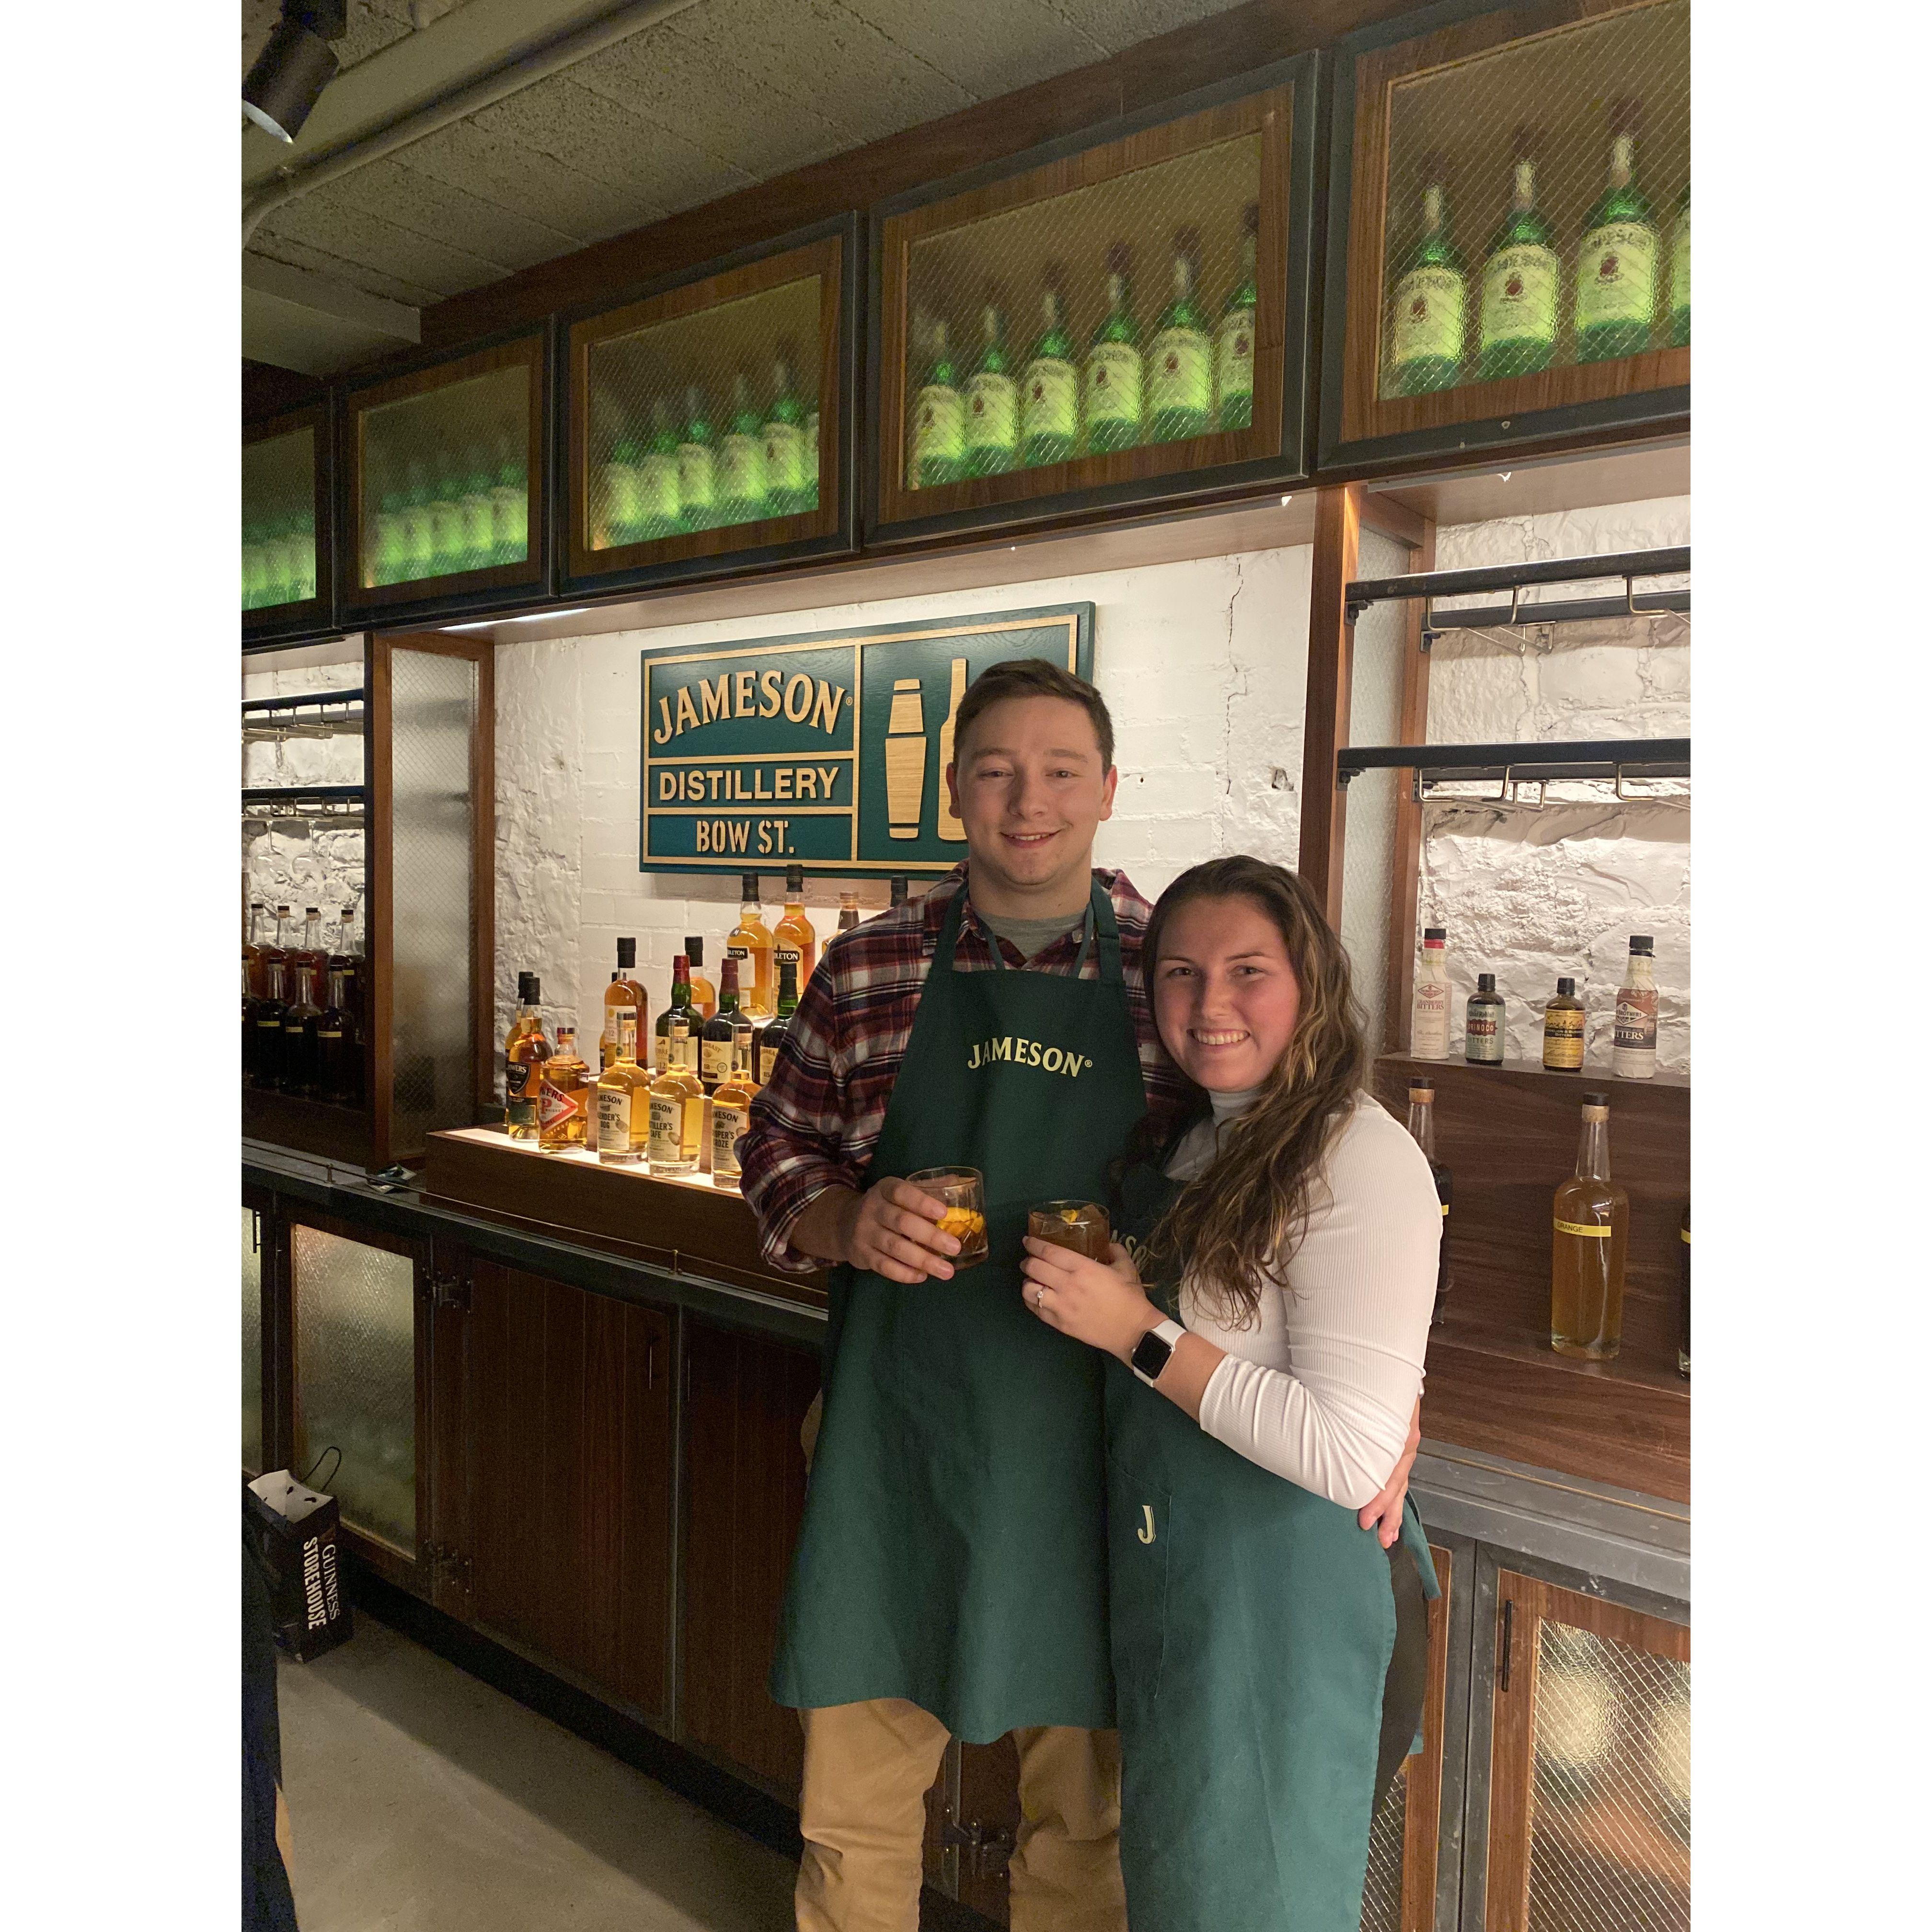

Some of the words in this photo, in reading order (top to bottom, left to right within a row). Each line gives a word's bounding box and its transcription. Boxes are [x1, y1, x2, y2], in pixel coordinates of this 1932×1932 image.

[660, 767, 839, 801] DISTILLERY
[696, 820, 750, 853] BOW
[758, 820, 795, 854] ST.
[1616, 1030, 1644, 1040] TTERS
[598, 1094, 623, 1105] MESON
[649, 1103, 673, 1115] MESON
[713, 1111, 739, 1123] MESON
[600, 1121, 610, 1129] DOG
[1557, 1221, 1583, 1233] ORANGE
[1138, 1505, 1156, 1544] J
[303, 1537, 327, 1630] STOREHOUSE
[322, 1544, 341, 1621] GUINNESS
